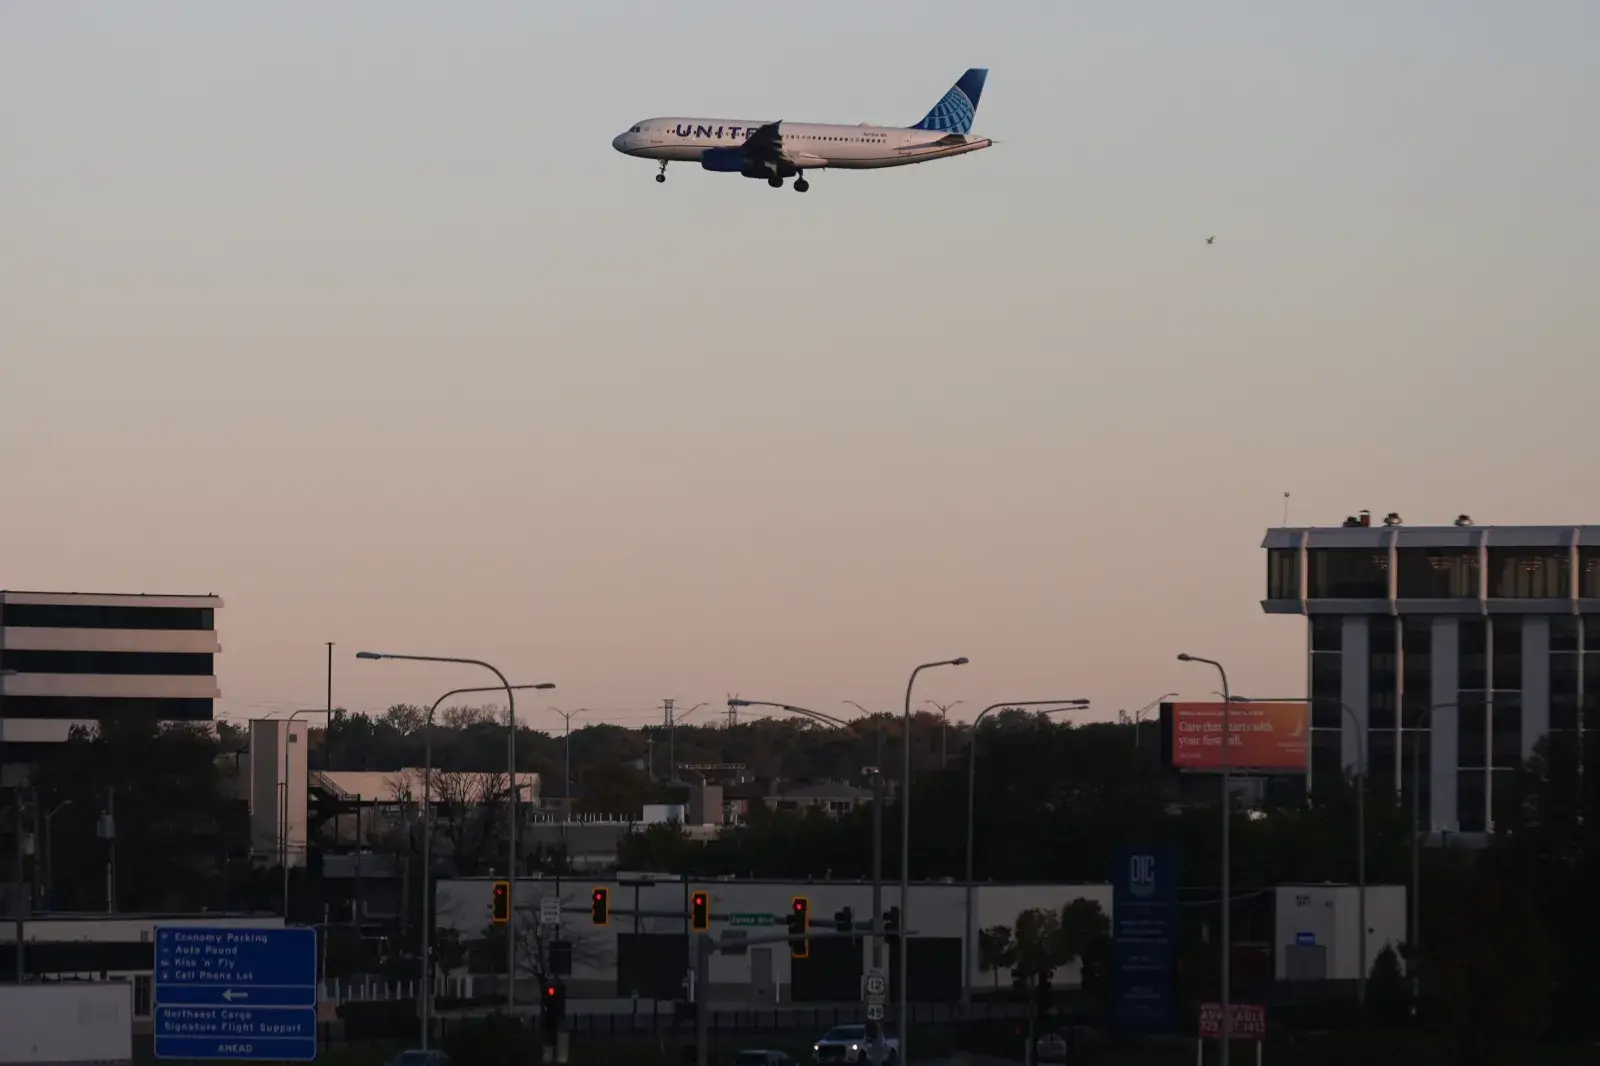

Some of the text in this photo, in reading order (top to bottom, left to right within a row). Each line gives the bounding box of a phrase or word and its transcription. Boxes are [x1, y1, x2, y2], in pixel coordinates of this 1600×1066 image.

[676, 124, 759, 139] UNITE
[1179, 721, 1202, 732] Care
[1203, 721, 1222, 732] that
[1252, 720, 1274, 732] with
[1178, 736, 1201, 749] your
[1202, 735, 1222, 746] first
[174, 932, 269, 944] Economy Parking
[175, 945, 238, 955] Auto Pound
[174, 958, 197, 967] Kiss
[218, 958, 236, 969] Fly
[175, 970, 253, 980] Cell Phone Lot
[870, 980, 882, 990] 12
[164, 1009, 252, 1021] Northeast Cargo
[869, 1007, 883, 1017] 45
[164, 1021, 302, 1033] Signature Flight Support
[218, 1043, 253, 1053] AHEAD
